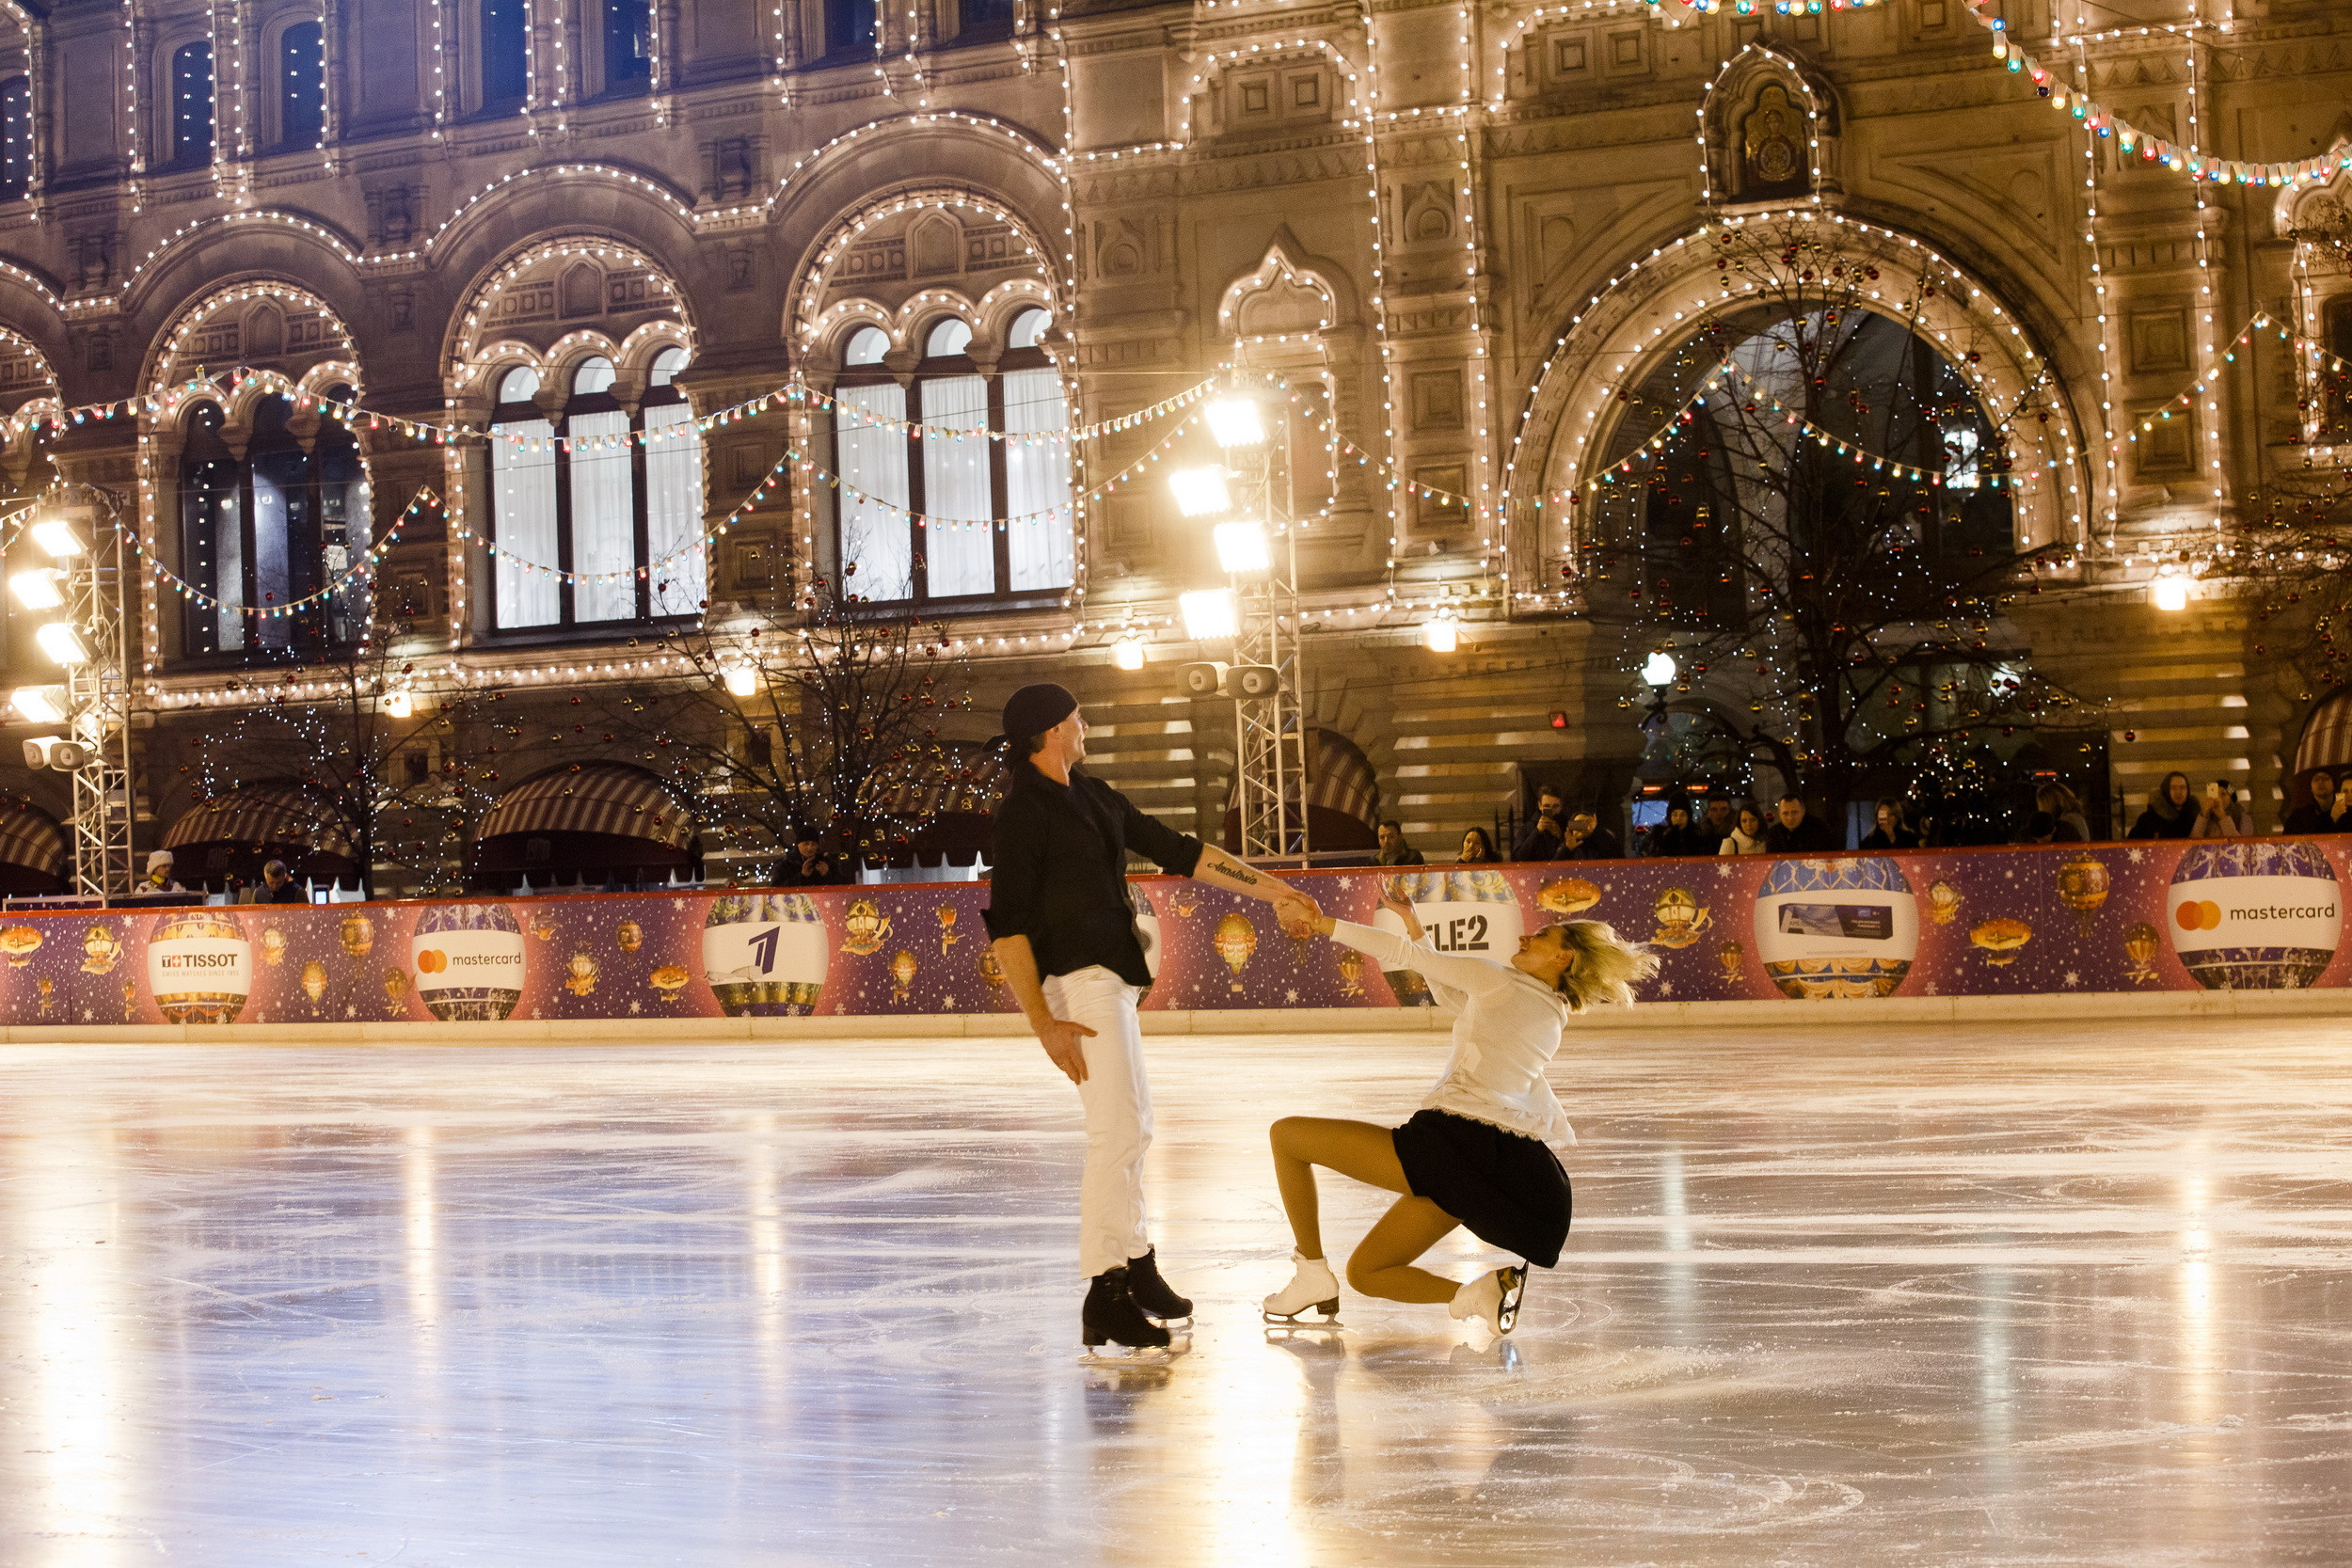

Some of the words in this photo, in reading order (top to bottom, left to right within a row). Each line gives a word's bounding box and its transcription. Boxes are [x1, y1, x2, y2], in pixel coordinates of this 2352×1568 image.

[1207, 862, 1257, 885] Anastasia
[2231, 903, 2335, 920] mastercard
[1422, 914, 1489, 951] LE2
[183, 954, 237, 967] TISSOT
[453, 952, 521, 965] mastercard
